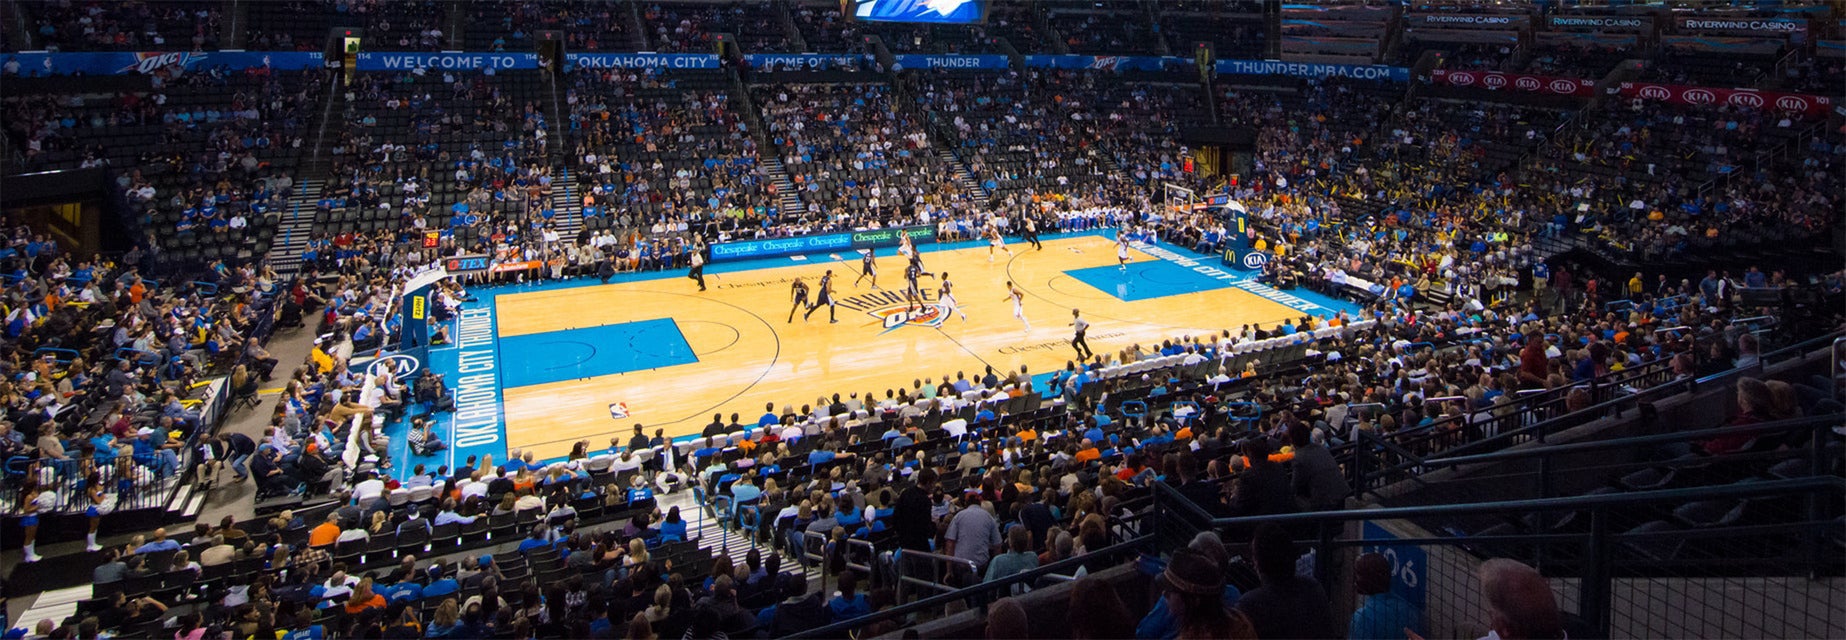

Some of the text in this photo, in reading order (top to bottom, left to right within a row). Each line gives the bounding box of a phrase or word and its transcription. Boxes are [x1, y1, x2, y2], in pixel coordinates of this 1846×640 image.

[1426, 15, 1509, 24] RIVERWIND CASINO
[1553, 17, 1641, 27] RIVERWIND CASINO
[1686, 19, 1796, 31] RIVERWIND CASINO
[383, 56, 515, 68] WELCOME TO
[578, 56, 708, 68] OKLAHOMA CITY
[926, 57, 980, 67] THUNDER
[1233, 61, 1390, 80] THUNDER.NBA.COM
[1816, 96, 1829, 104] 101
[809, 232, 849, 247] Chesapeake
[853, 230, 893, 244] Chesapeake
[896, 226, 933, 240] Cesapeake
[714, 243, 758, 256] Chesapeake
[763, 238, 805, 251] Chesapeake
[1247, 255, 1263, 266] KIA
[1192, 266, 1237, 280] CITY
[1230, 277, 1321, 312] THUNDER
[414, 297, 423, 316] Hertz
[455, 306, 499, 448] OKLAHOMA CITY THUNDER
